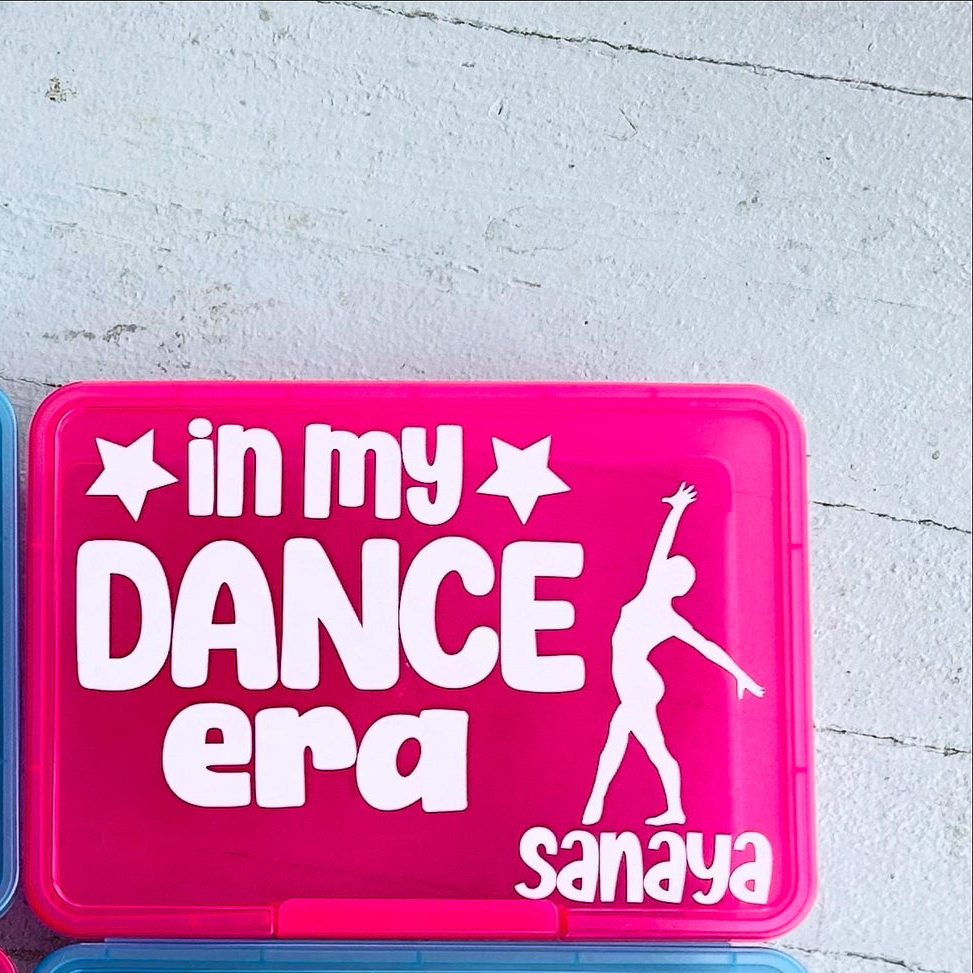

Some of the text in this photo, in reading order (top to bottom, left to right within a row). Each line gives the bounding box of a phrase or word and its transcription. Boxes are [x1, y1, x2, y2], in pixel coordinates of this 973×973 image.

[189, 419, 462, 524] in my
[77, 537, 584, 692] DANCE
[163, 703, 468, 812] era
